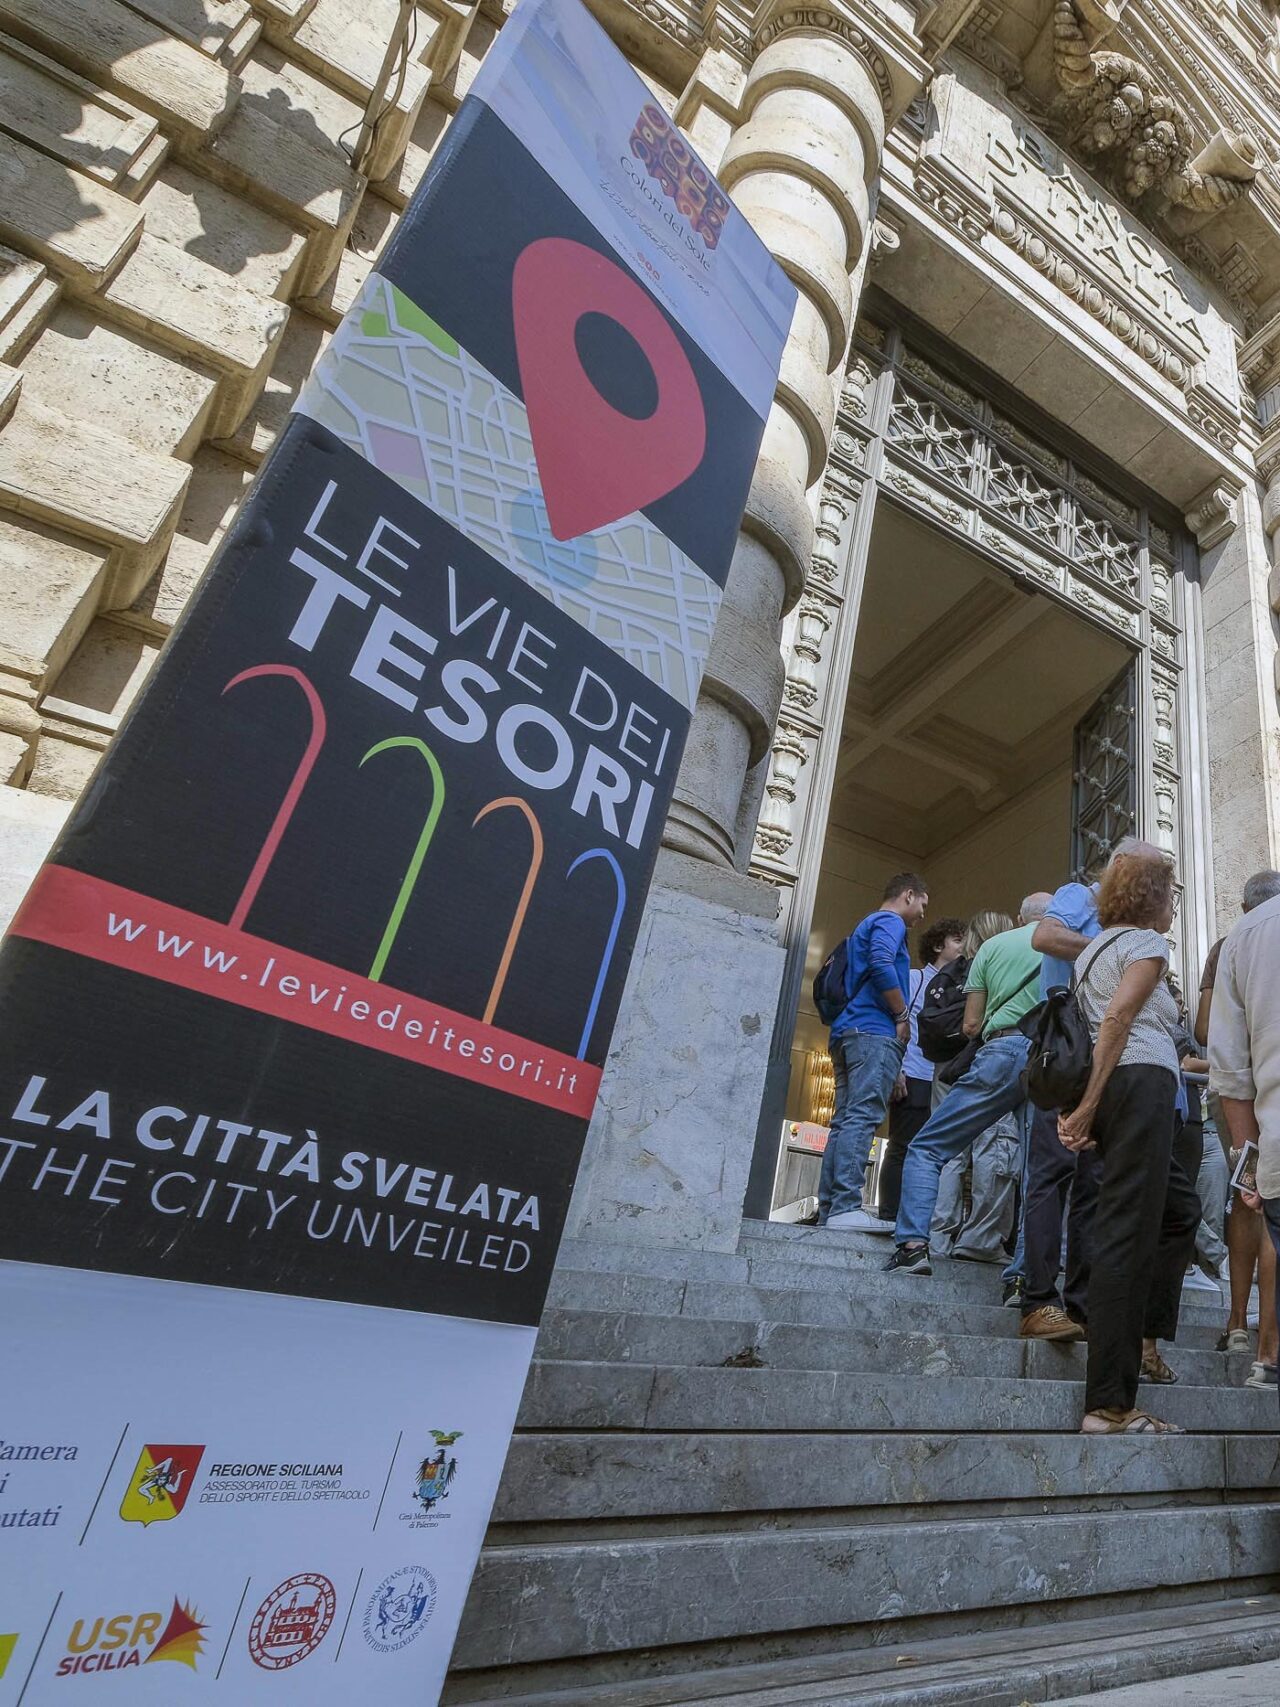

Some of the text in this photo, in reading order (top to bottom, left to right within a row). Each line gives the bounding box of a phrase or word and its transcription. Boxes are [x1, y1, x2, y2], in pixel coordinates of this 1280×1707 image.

[619, 155, 711, 272] Colori del Sole
[303, 479, 671, 777] LE VIE DEI
[287, 546, 655, 850] TESORI
[106, 911, 579, 1097] www.leviedeitesori.it
[11, 1074, 542, 1231] LA CITTÀ SVELATA
[0, 1139, 532, 1274] THE CITY UNVEILED
[0, 1440, 78, 1461] amera
[209, 1463, 343, 1477] REGIONE SICILIANA
[199, 1489, 371, 1503] DELLO SPORT E DELLO SPETTACOLO
[203, 1479, 342, 1491] ASSESSORATO DEL TURISMO
[0, 1505, 62, 1528] utati
[67, 1612, 162, 1654] USR
[56, 1648, 140, 1677] SICILIA
